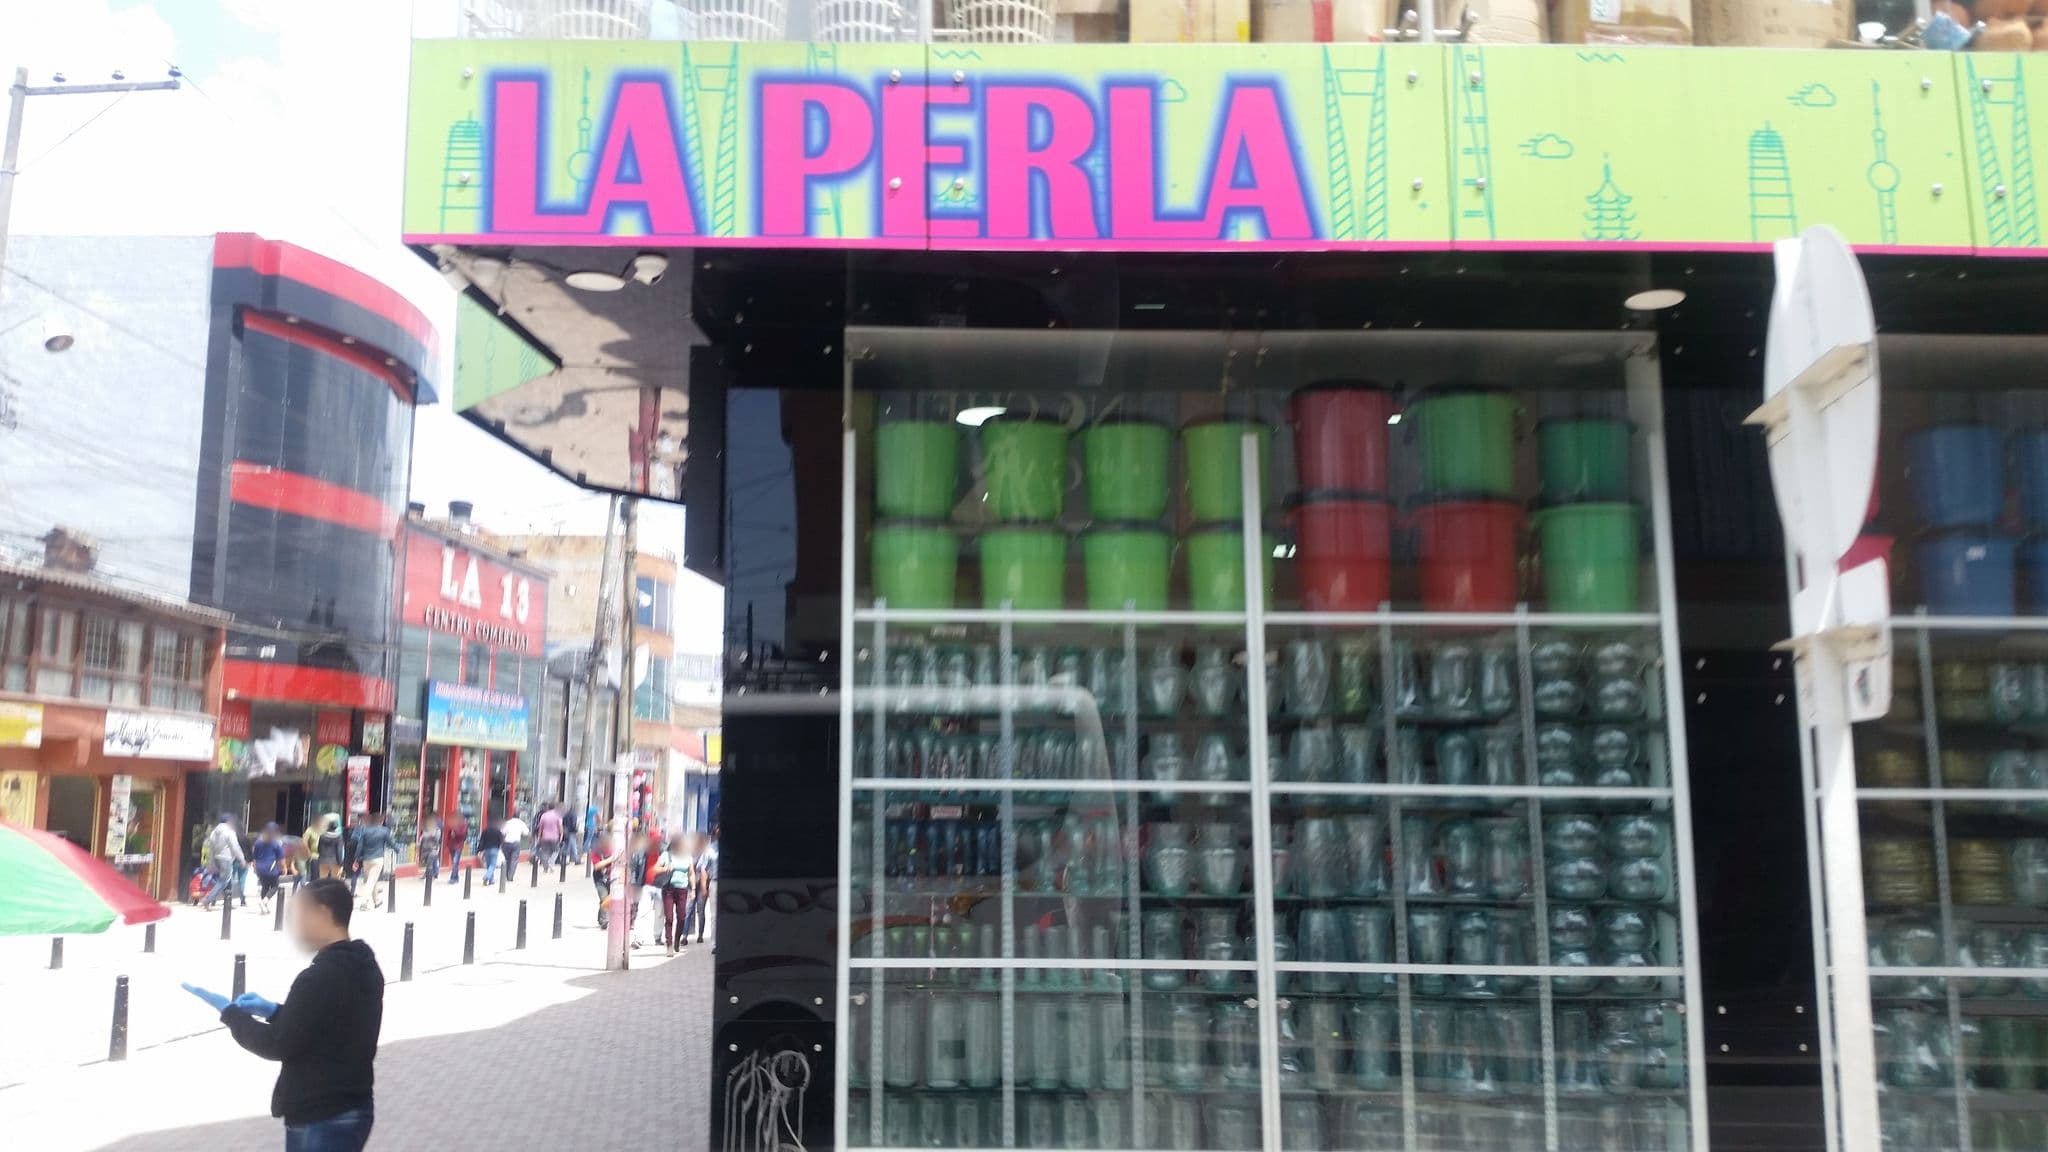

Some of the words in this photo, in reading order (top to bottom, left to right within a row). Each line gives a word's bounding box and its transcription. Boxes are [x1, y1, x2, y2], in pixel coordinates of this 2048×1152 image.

[488, 76, 700, 237] LA
[757, 79, 1316, 241] PERLA
[440, 546, 482, 610] LA
[500, 571, 530, 625] 13
[425, 603, 471, 635] CENTRO
[475, 618, 529, 652] COMERCIAL
